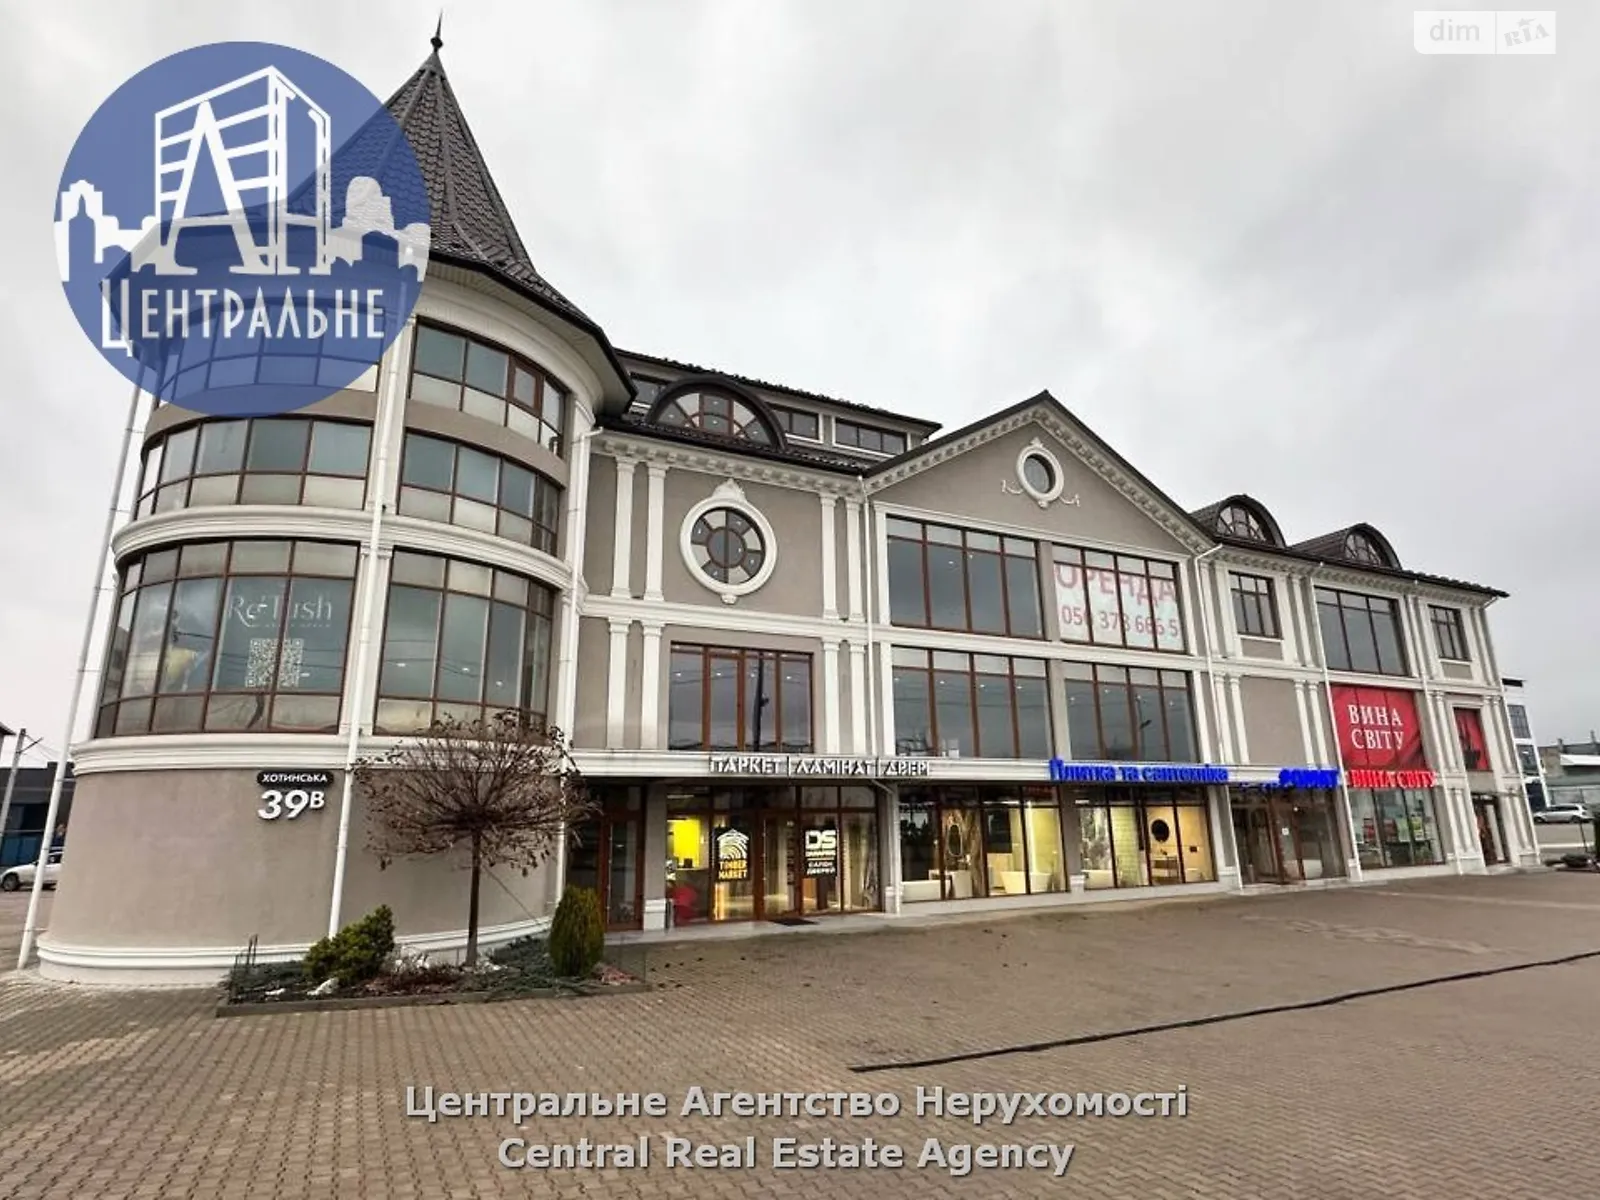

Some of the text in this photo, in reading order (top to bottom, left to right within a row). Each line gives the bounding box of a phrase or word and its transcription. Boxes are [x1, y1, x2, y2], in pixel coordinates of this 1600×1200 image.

[1347, 704, 1404, 726] ВИНА
[1351, 728, 1405, 750] СВІТУ
[709, 756, 782, 774] ПАРКЕТ
[796, 758, 872, 775] ЛАМІНАТ
[1049, 759, 1116, 782] Плитка
[1118, 766, 1140, 782] та
[262, 773, 328, 783] ХОТИНСЬКА
[258, 789, 325, 820] 39В
[805, 829, 836, 849] DS
